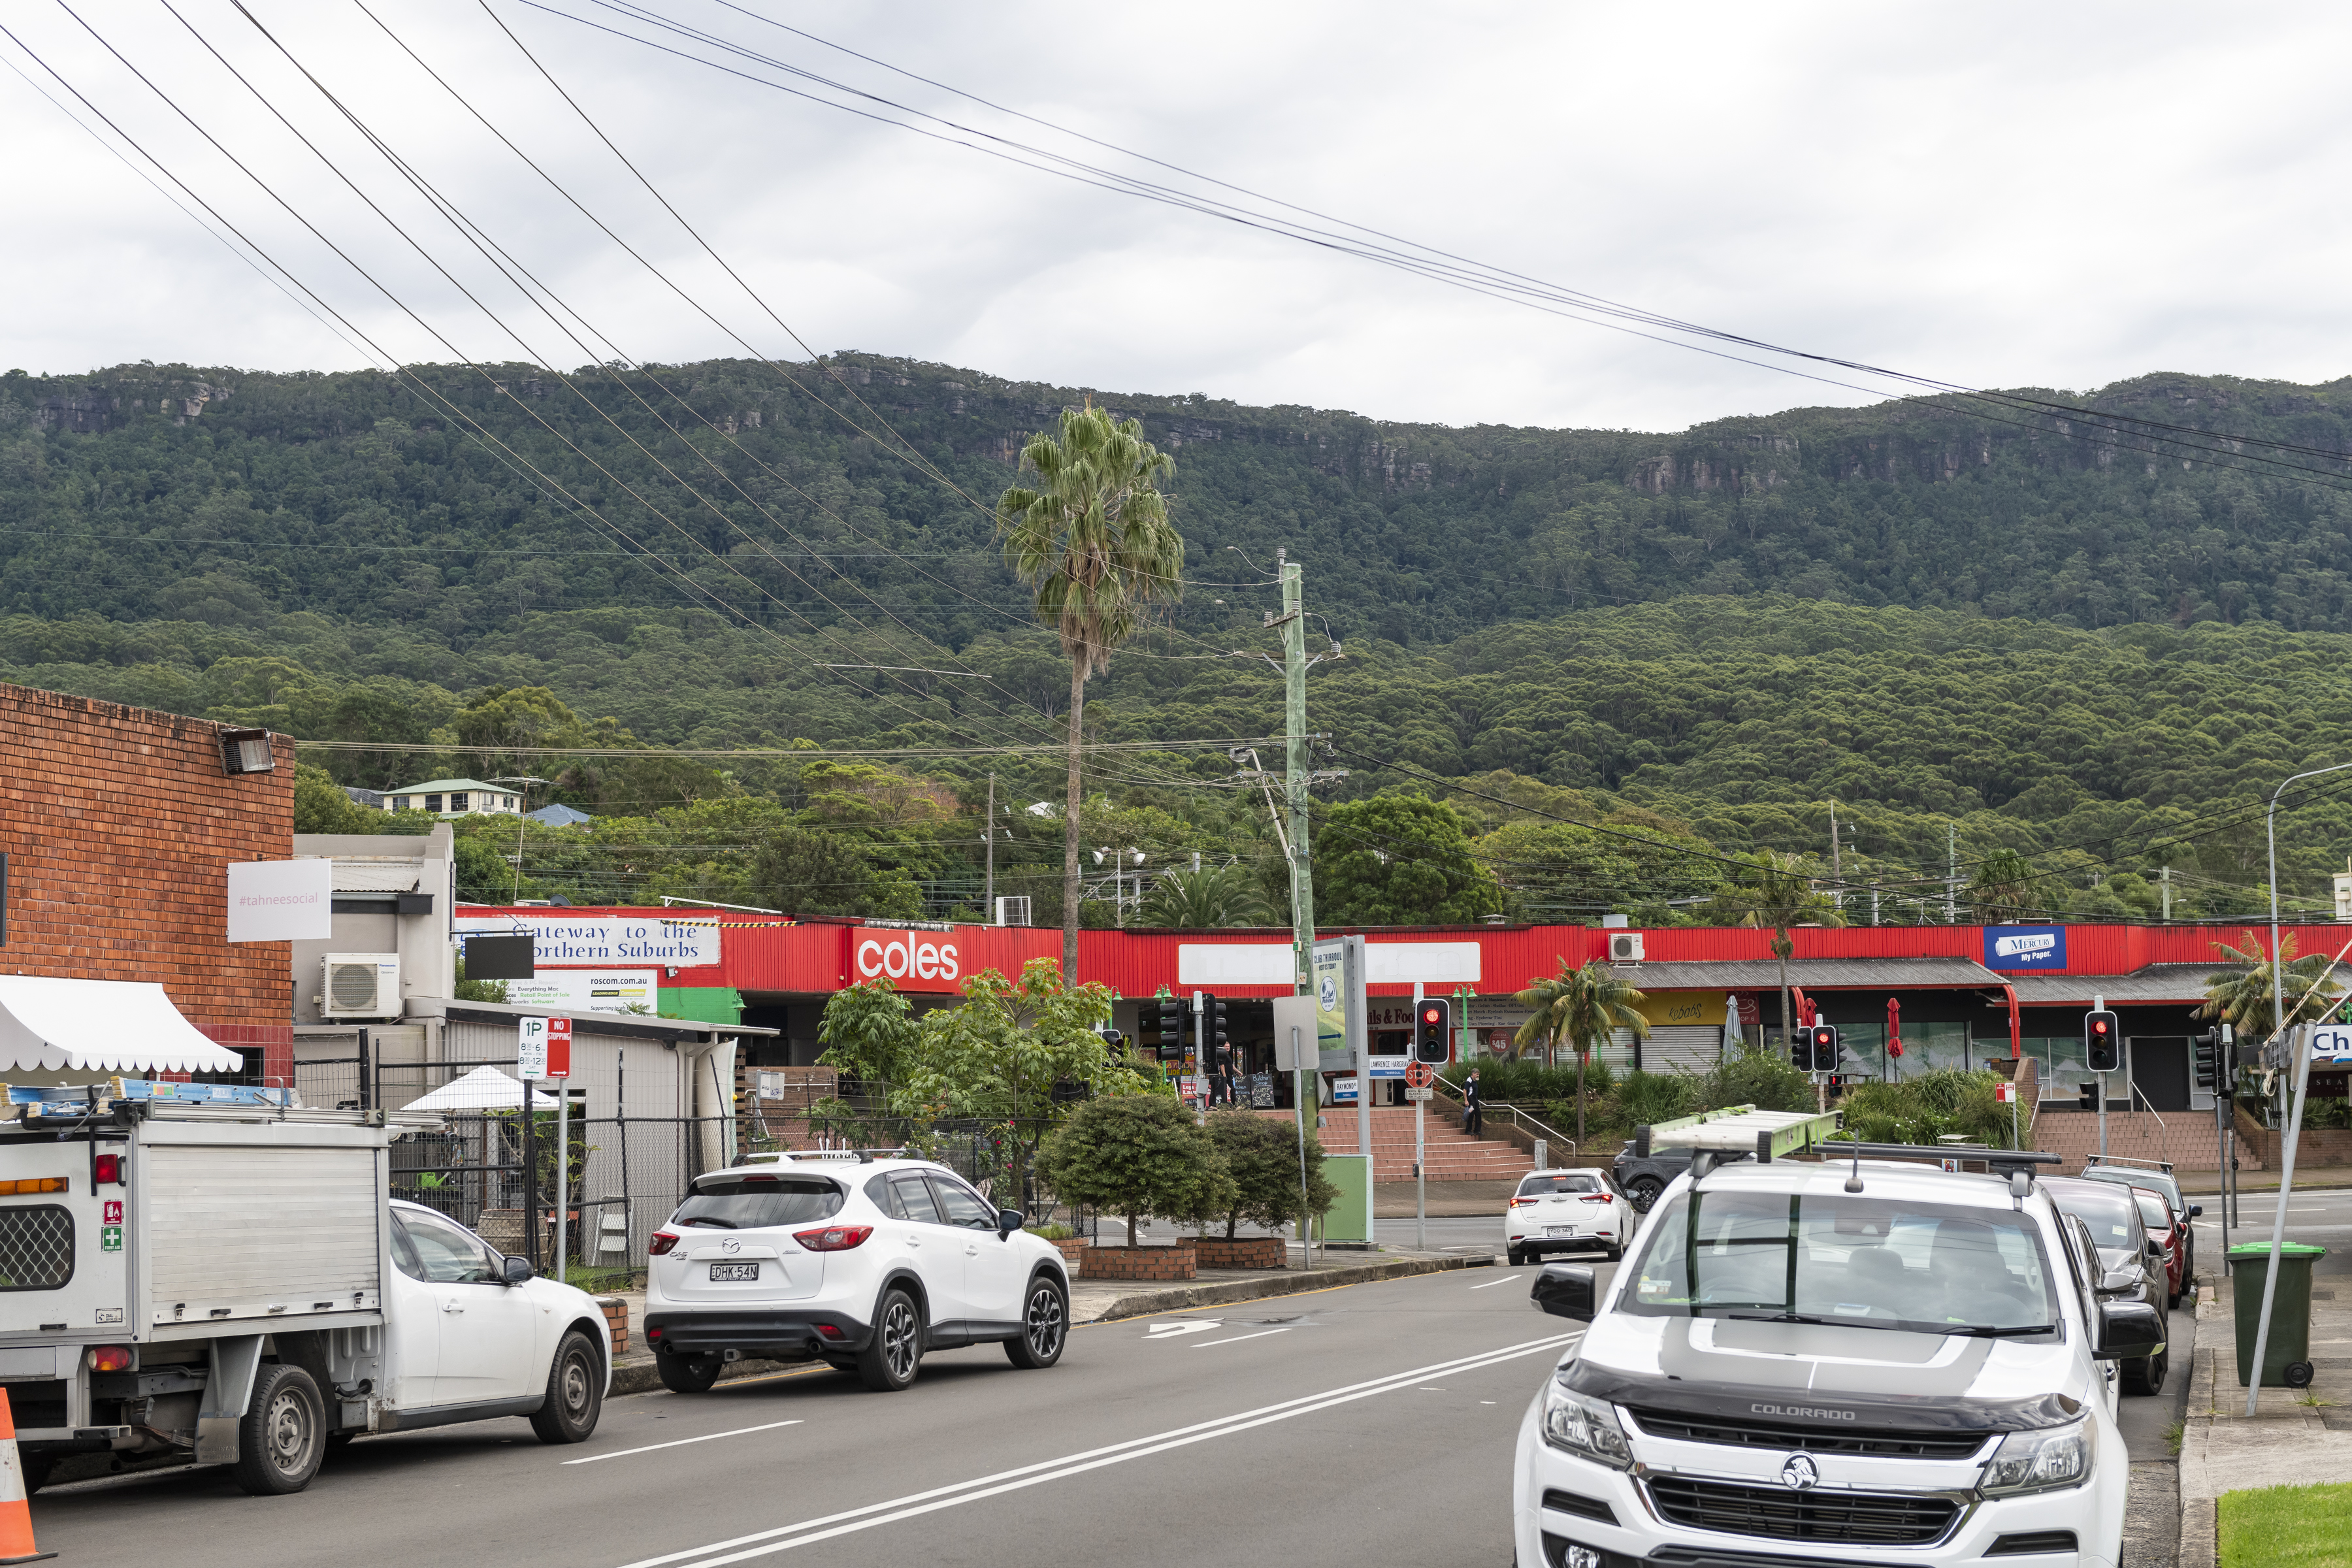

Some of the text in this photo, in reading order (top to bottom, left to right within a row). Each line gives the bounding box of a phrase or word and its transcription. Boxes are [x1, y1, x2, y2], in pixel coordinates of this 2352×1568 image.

[239, 892, 318, 906] #tahneesocial
[513, 924, 610, 943] Gateway
[625, 927, 646, 938] to
[664, 925, 697, 938] the
[533, 941, 698, 958] orthern Suburbs
[2010, 938, 2050, 951] MERCURY
[858, 932, 958, 980] coles
[1314, 952, 1342, 964] CLUB THIRROUL
[2021, 951, 2051, 962] My Paper.
[1367, 1009, 1414, 1024] ils & Foo
[526, 1022, 542, 1036] 1P
[554, 1021, 564, 1030] NO
[547, 1032, 570, 1041] STOPPING
[2313, 1032, 2349, 1051] Ch
[1492, 1039, 1506, 1049] $45
[1408, 1070, 1430, 1079] STOP
[1751, 1403, 1855, 1420] COLORADO
